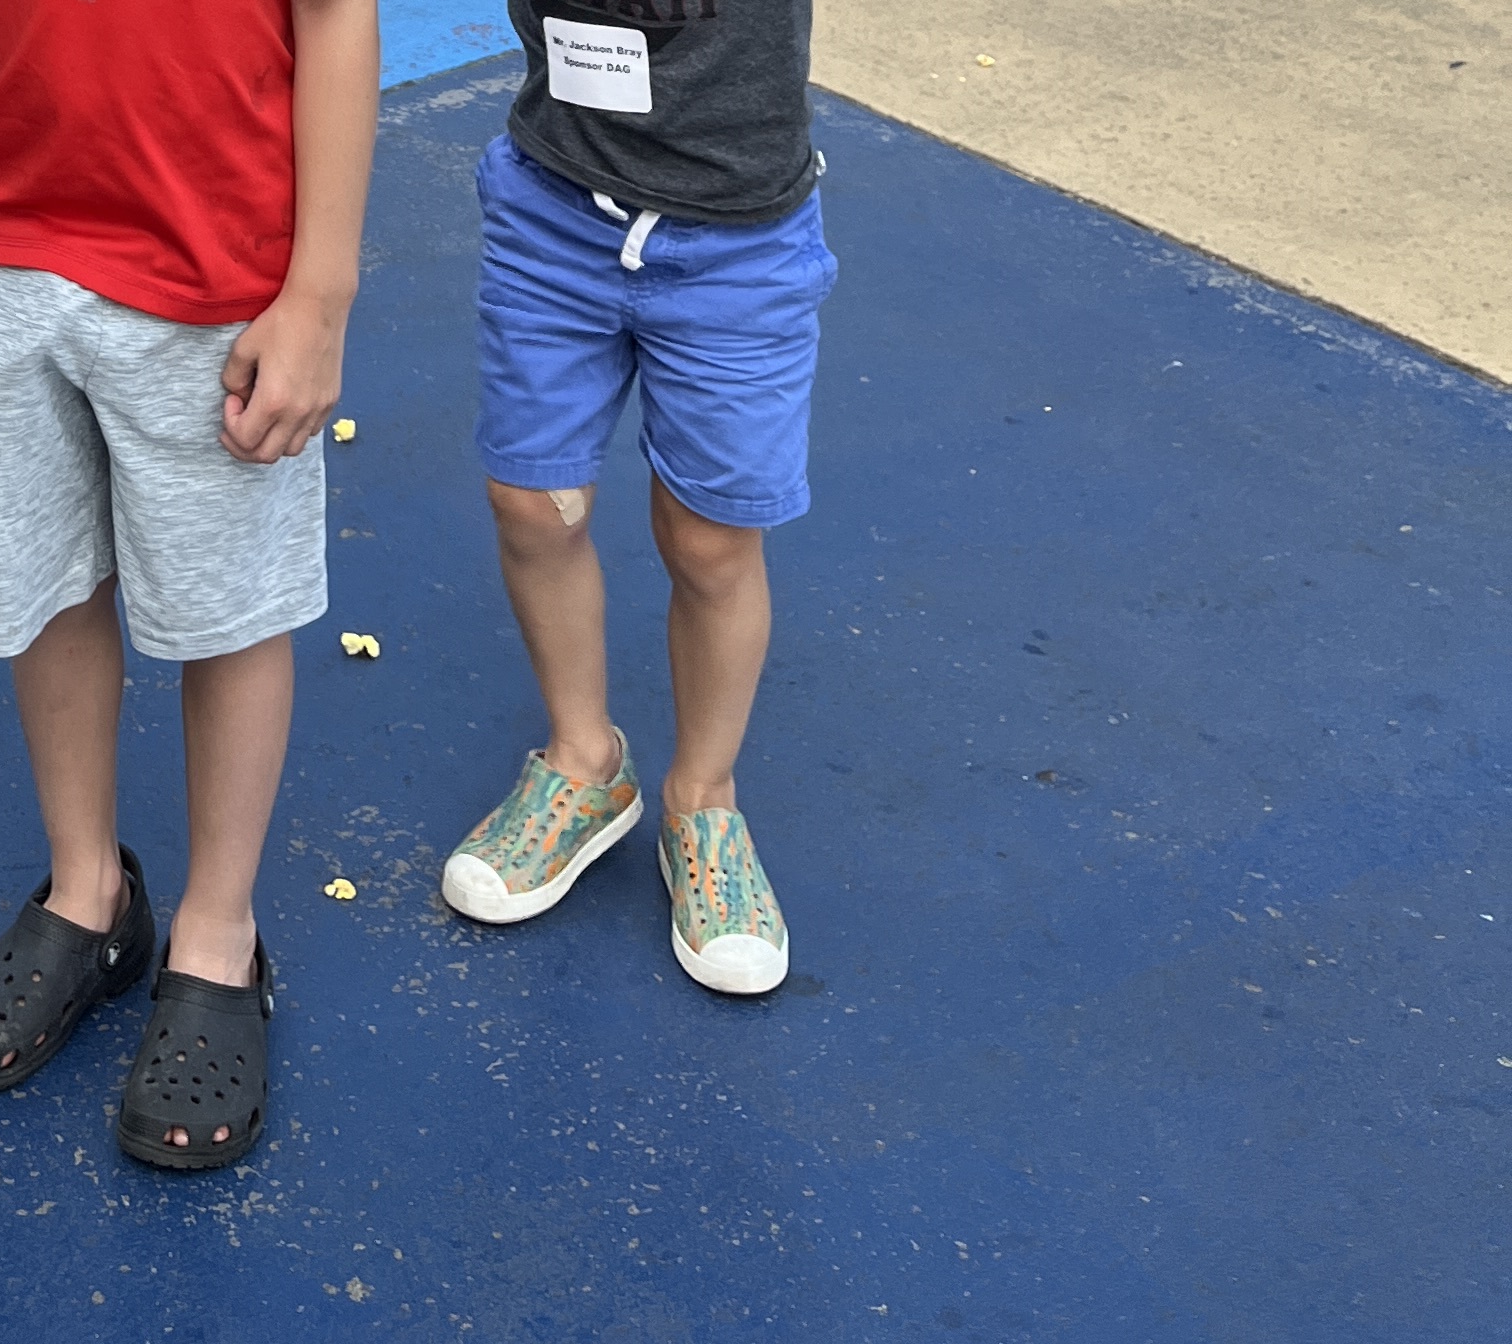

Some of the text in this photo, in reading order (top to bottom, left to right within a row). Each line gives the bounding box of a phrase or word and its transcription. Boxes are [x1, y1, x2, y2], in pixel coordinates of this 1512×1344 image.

[569, 40, 614, 54] Jackson
[616, 46, 643, 59] Bray
[606, 62, 631, 74] DAG
